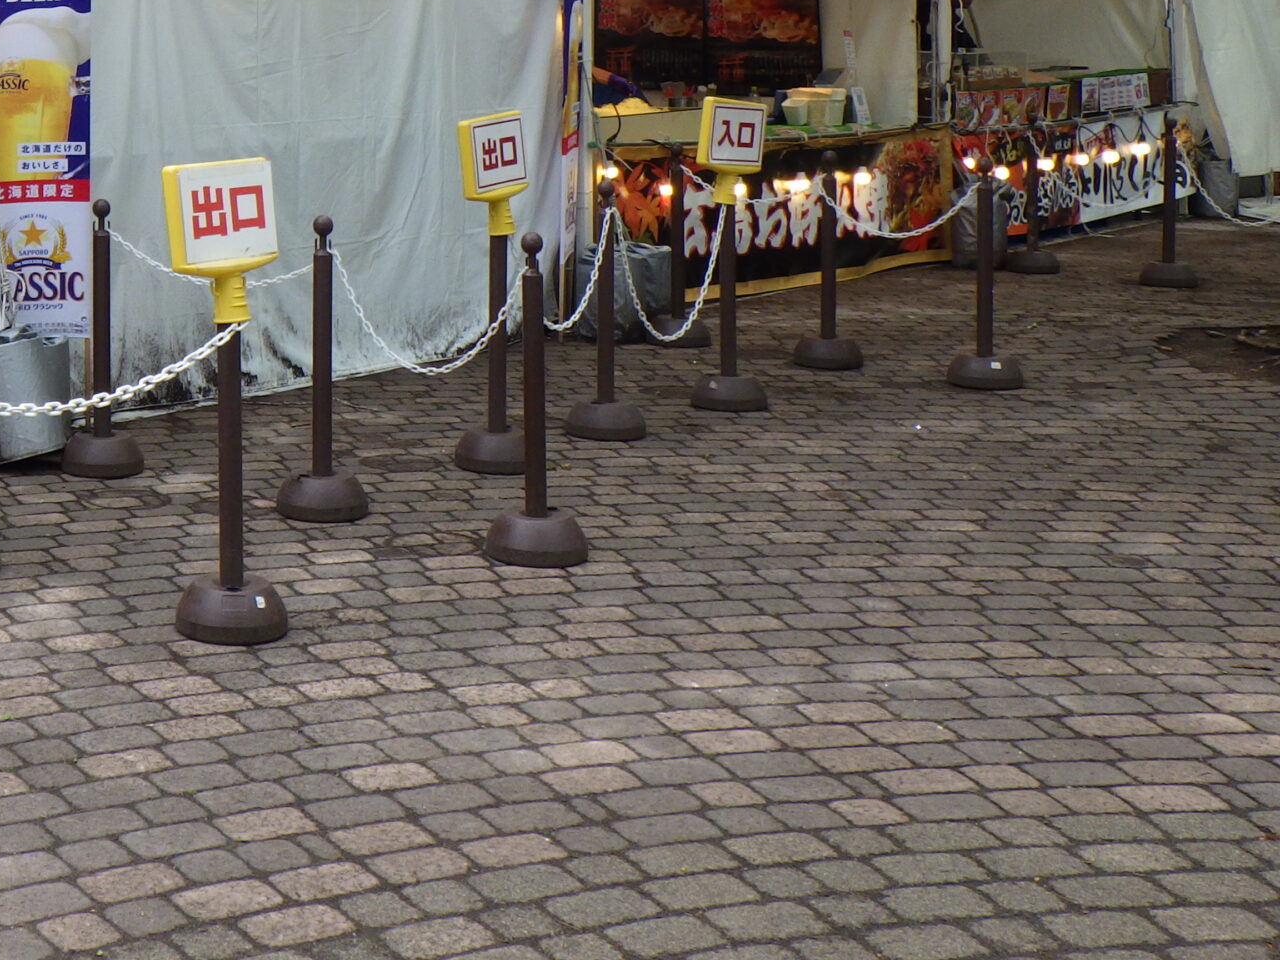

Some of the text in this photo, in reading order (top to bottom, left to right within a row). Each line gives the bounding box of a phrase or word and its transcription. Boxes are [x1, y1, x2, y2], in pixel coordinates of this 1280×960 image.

[21, 143, 83, 154] 北海道だけの
[718, 120, 755, 148] 入口
[482, 135, 518, 171] 出口
[191, 184, 266, 240] 出口
